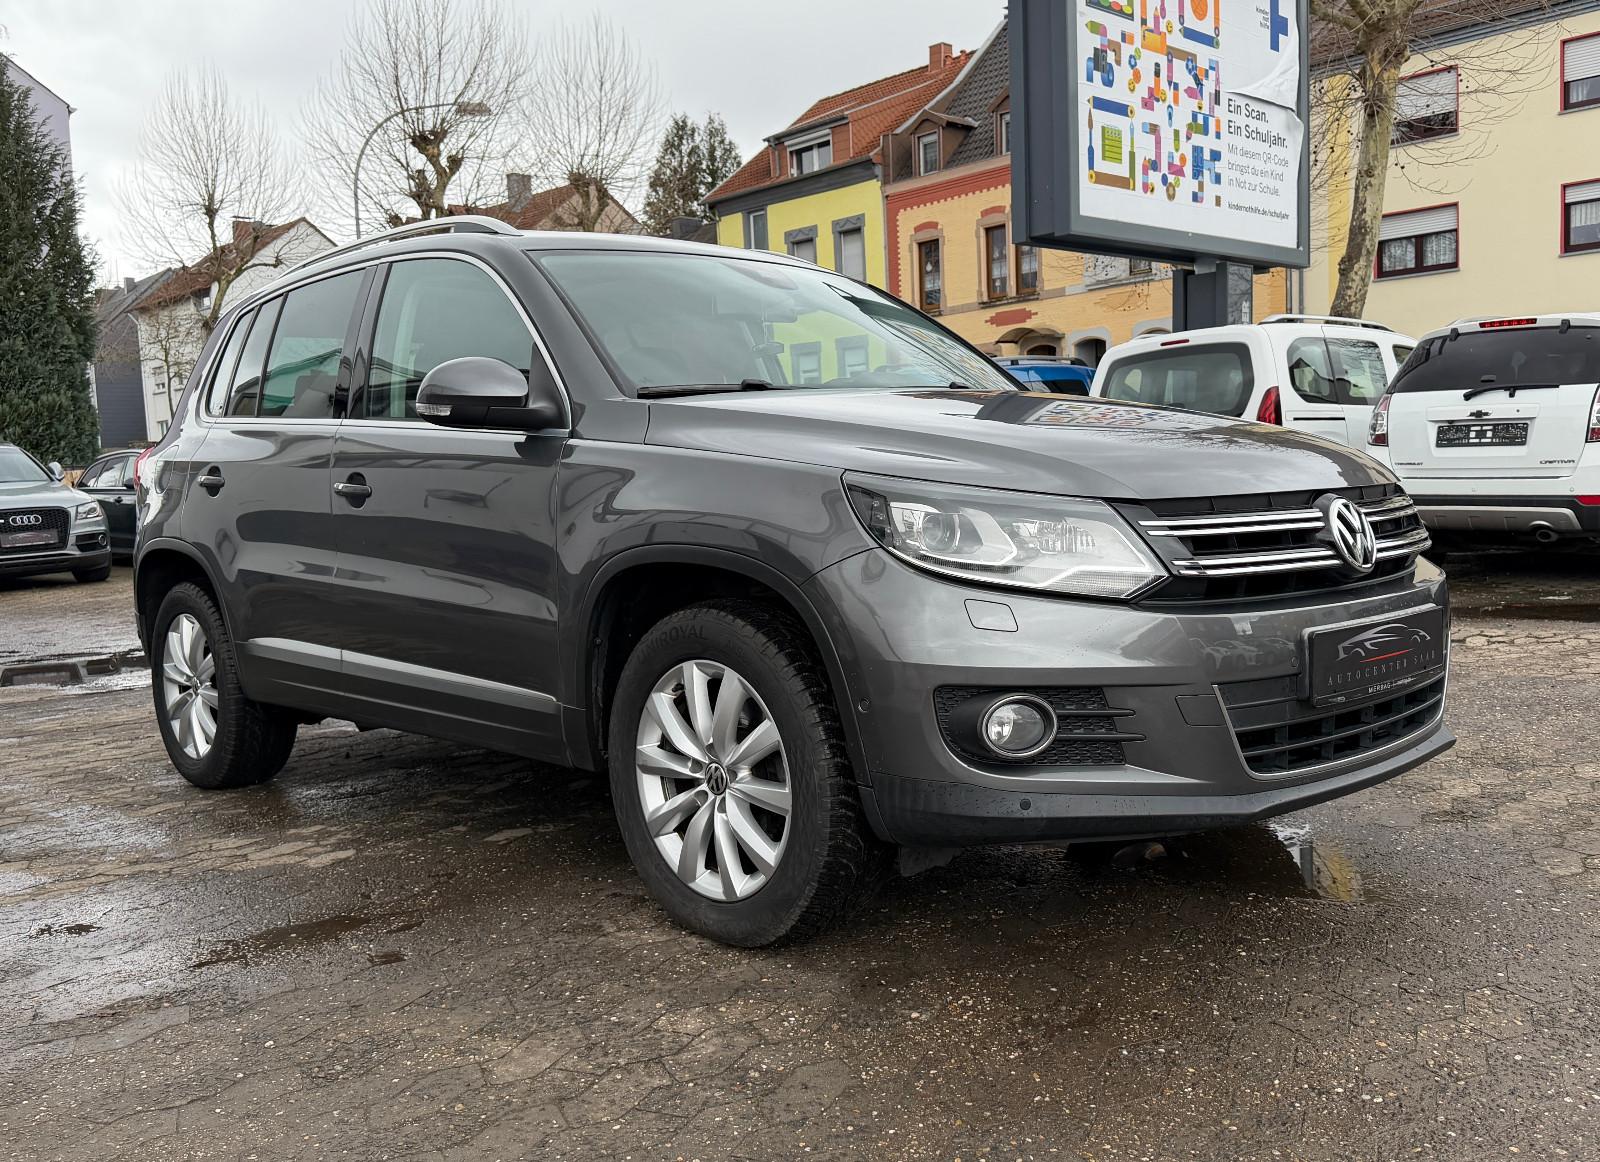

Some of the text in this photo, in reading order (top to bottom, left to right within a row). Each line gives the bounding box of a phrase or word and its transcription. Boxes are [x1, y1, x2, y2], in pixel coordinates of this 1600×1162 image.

[1227, 98, 1269, 123] Ein Scan.
[1227, 120, 1288, 149] Ein Schuljahr.
[1227, 143, 1289, 168] Mit diesem QR-Code
[1227, 159, 1284, 182] bringst du ein Kind
[1227, 175, 1281, 197] in Not zur Schule.
[1227, 201, 1290, 220] kindernothilfe.de/schuljahr
[1327, 658, 1407, 686] AUTOCENTER
[1413, 649, 1436, 665] SAAR
